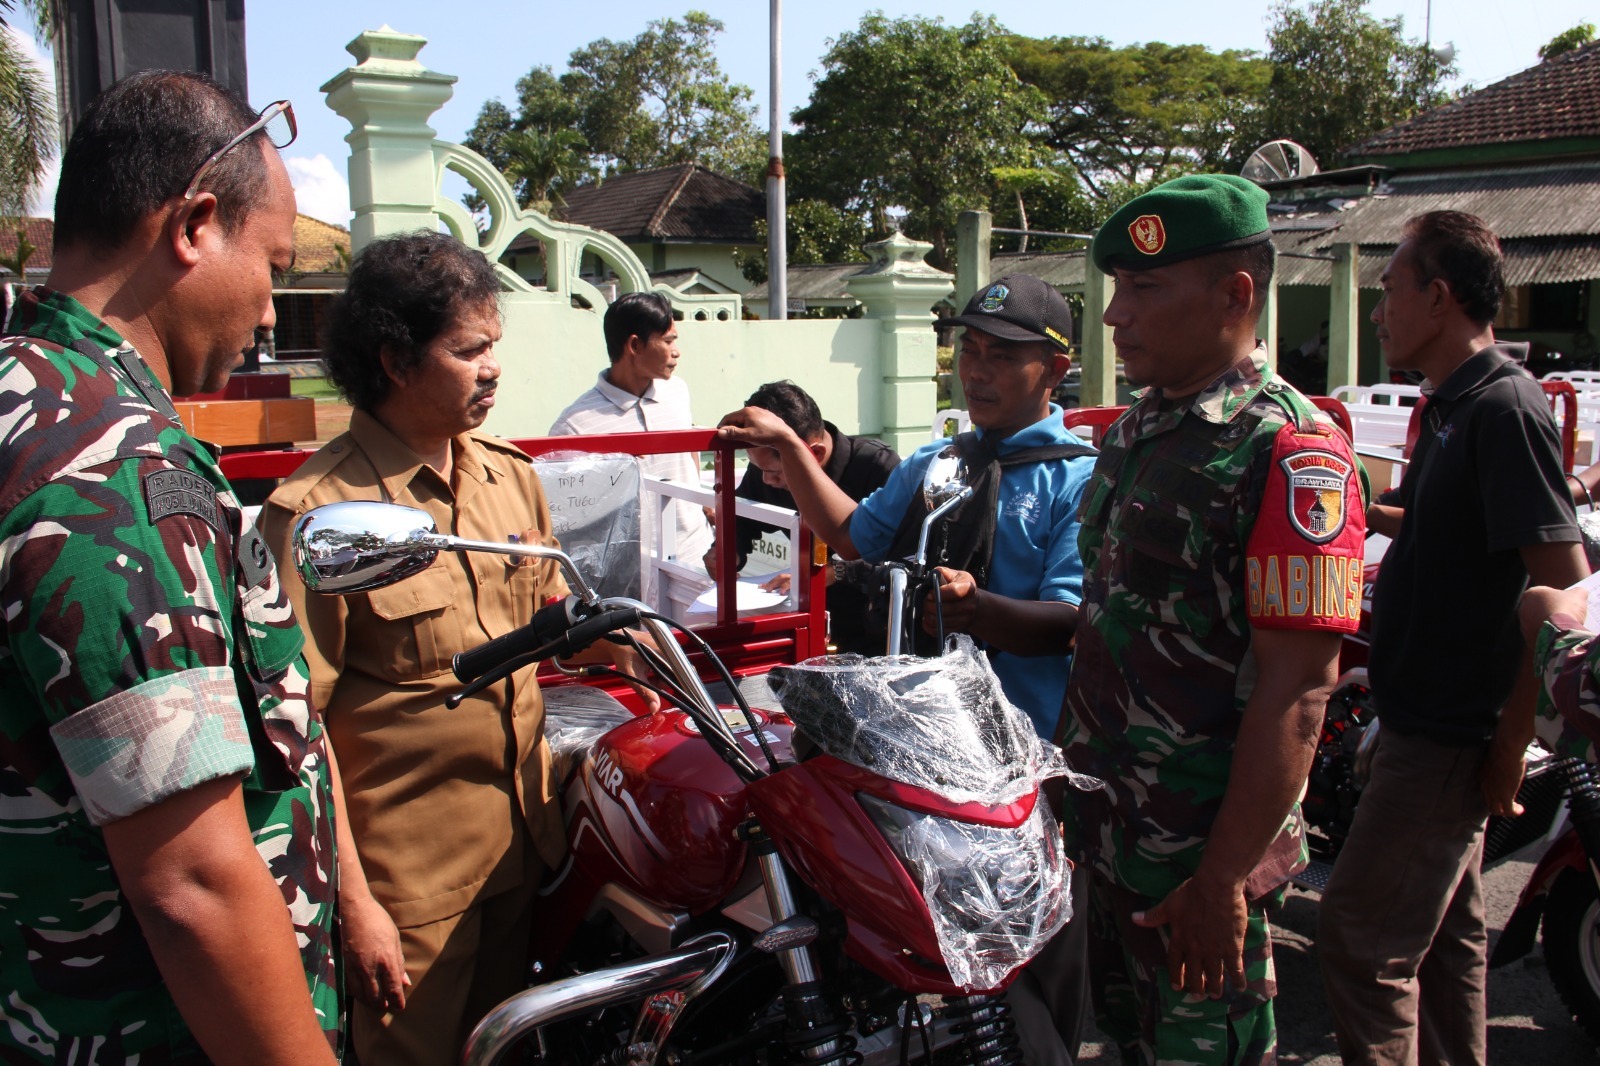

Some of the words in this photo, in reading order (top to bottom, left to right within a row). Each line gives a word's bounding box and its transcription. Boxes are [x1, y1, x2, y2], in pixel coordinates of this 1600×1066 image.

[1289, 456, 1323, 471] KODIM
[153, 474, 212, 500] RAIDER
[1294, 477, 1341, 488] BRAWIJAYA
[155, 493, 188, 515] MOBIL
[1246, 555, 1364, 621] BABINS
[595, 746, 624, 797] VIAR
